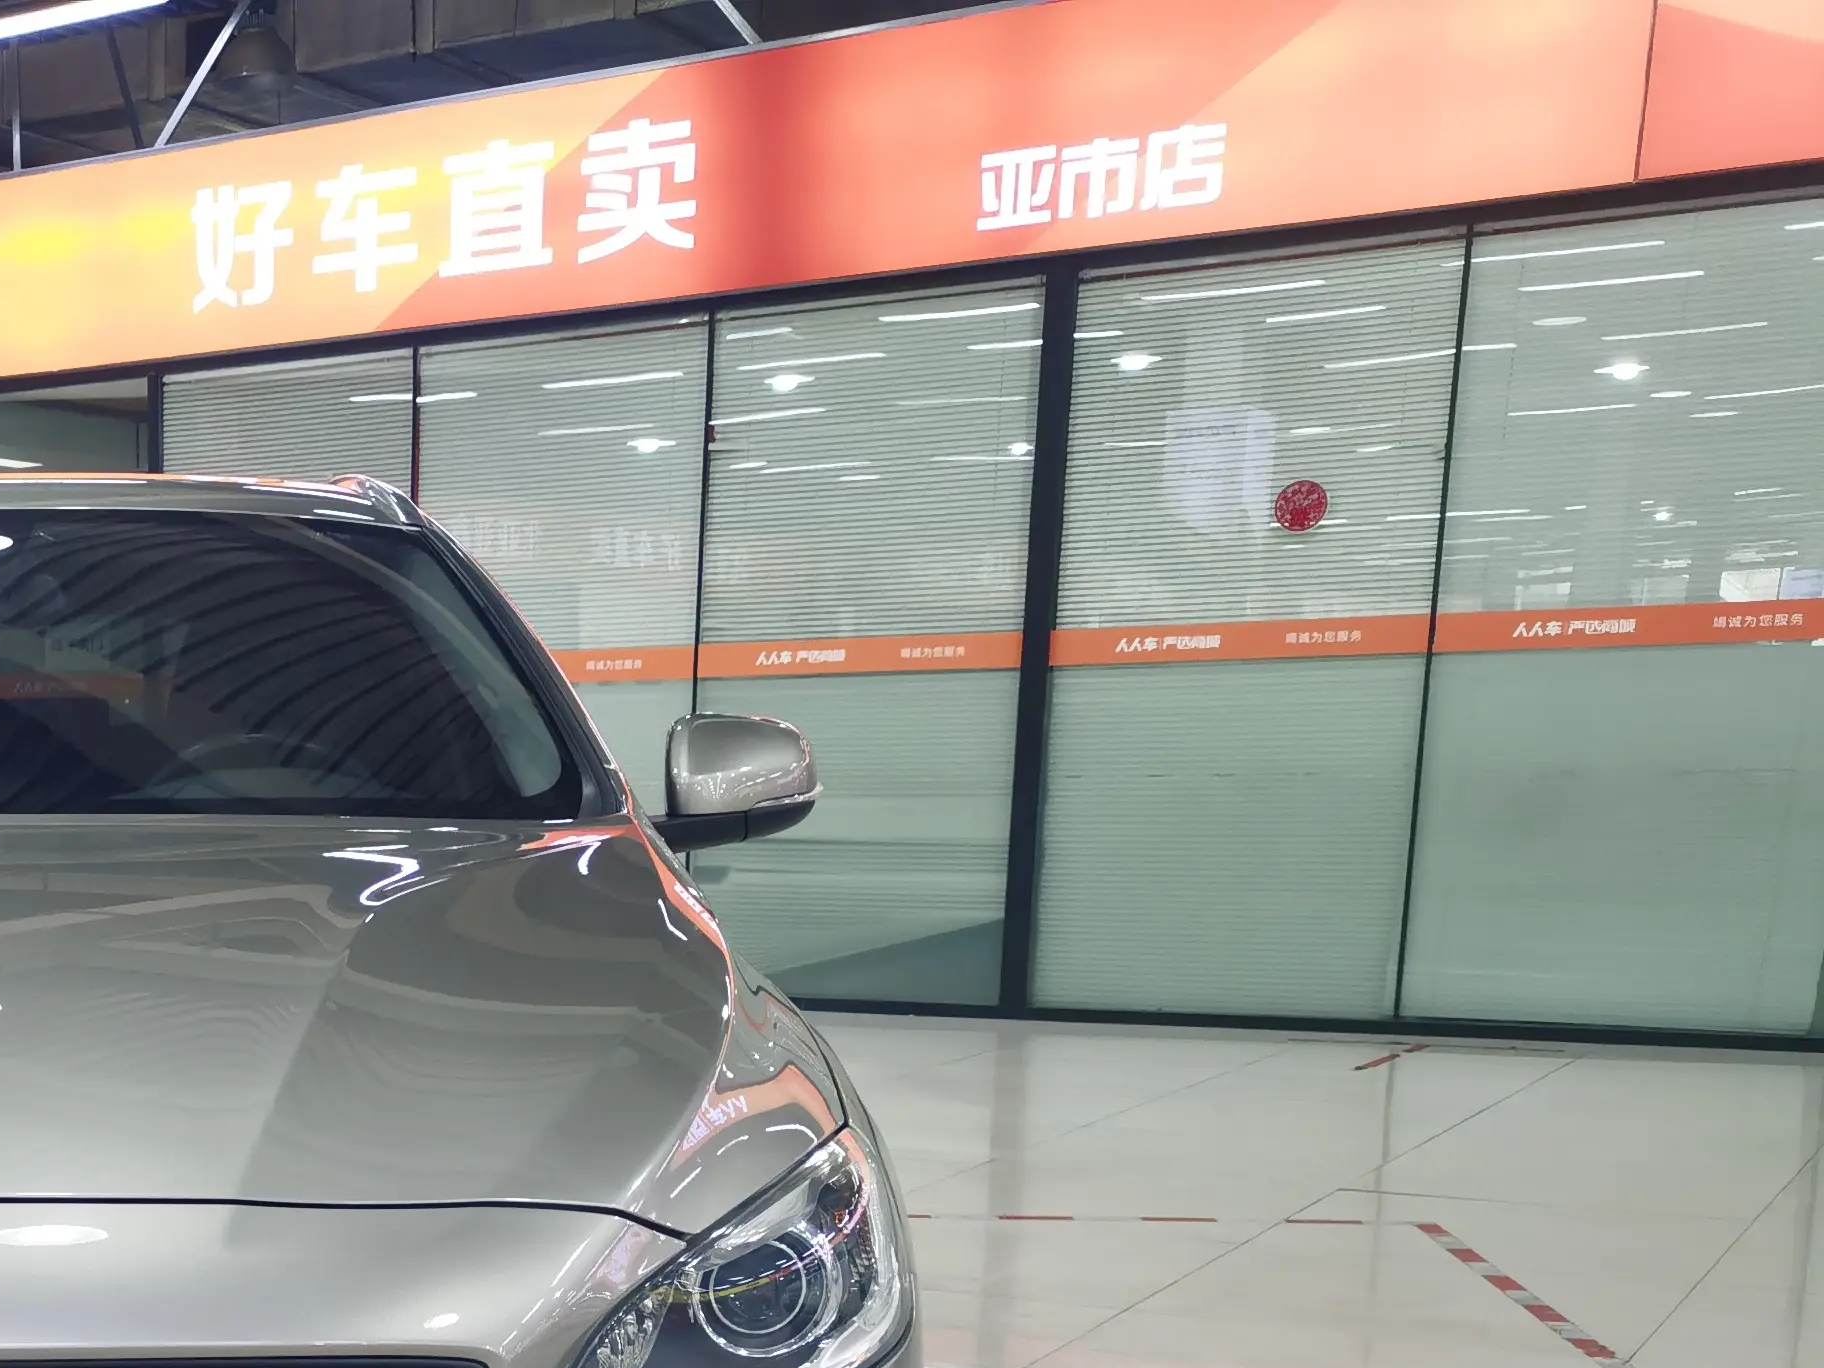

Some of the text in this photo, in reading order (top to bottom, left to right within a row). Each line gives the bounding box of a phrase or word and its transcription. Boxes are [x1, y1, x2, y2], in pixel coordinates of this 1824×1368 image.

[192, 117, 697, 314] 好车直卖
[977, 123, 1228, 232] 亚市店
